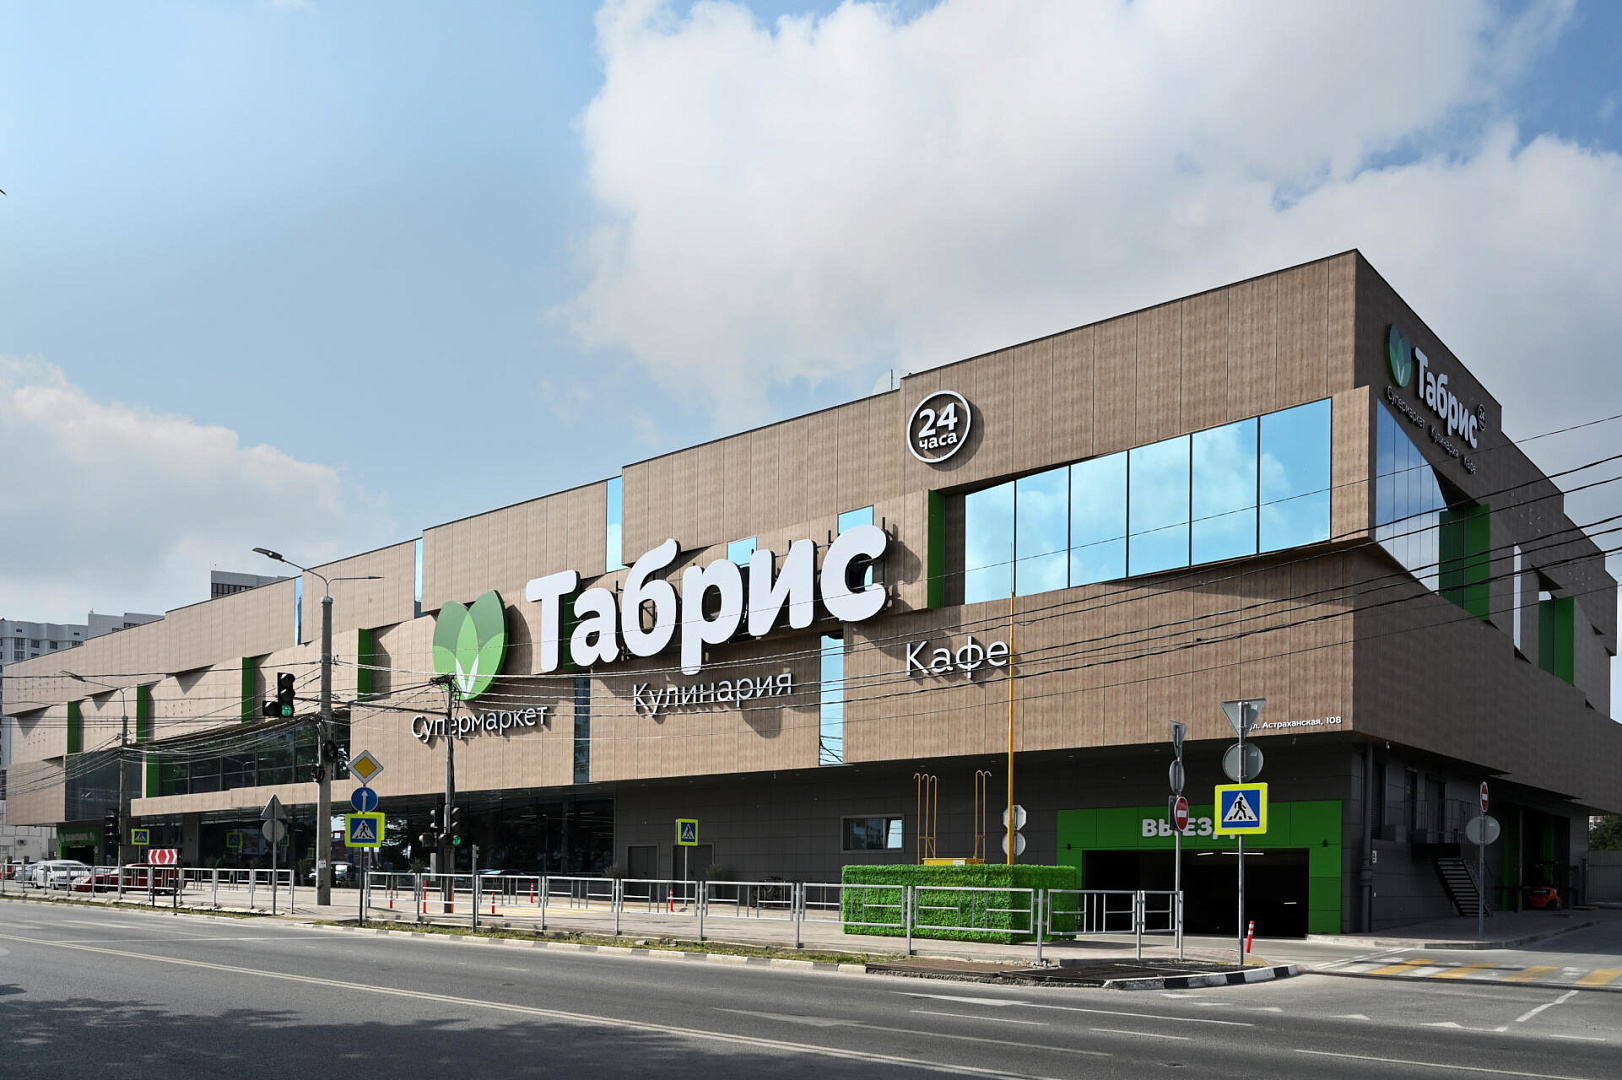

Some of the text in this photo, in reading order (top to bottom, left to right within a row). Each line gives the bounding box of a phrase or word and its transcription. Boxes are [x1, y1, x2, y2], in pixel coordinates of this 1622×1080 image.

[1387, 385, 1425, 429] Супермаркет
[1415, 347, 1478, 449] Табрис
[919, 403, 959, 438] 24
[919, 431, 958, 451] часа
[526, 525, 888, 676] Табрис
[906, 635, 1011, 679] Кафе
[633, 673, 792, 718] Кулинария
[411, 705, 549, 744] Супермаркет
[1262, 718, 1323, 730] Астраханская,
[1326, 716, 1342, 724] 108
[1142, 817, 1236, 840] ВЫЕЗ
